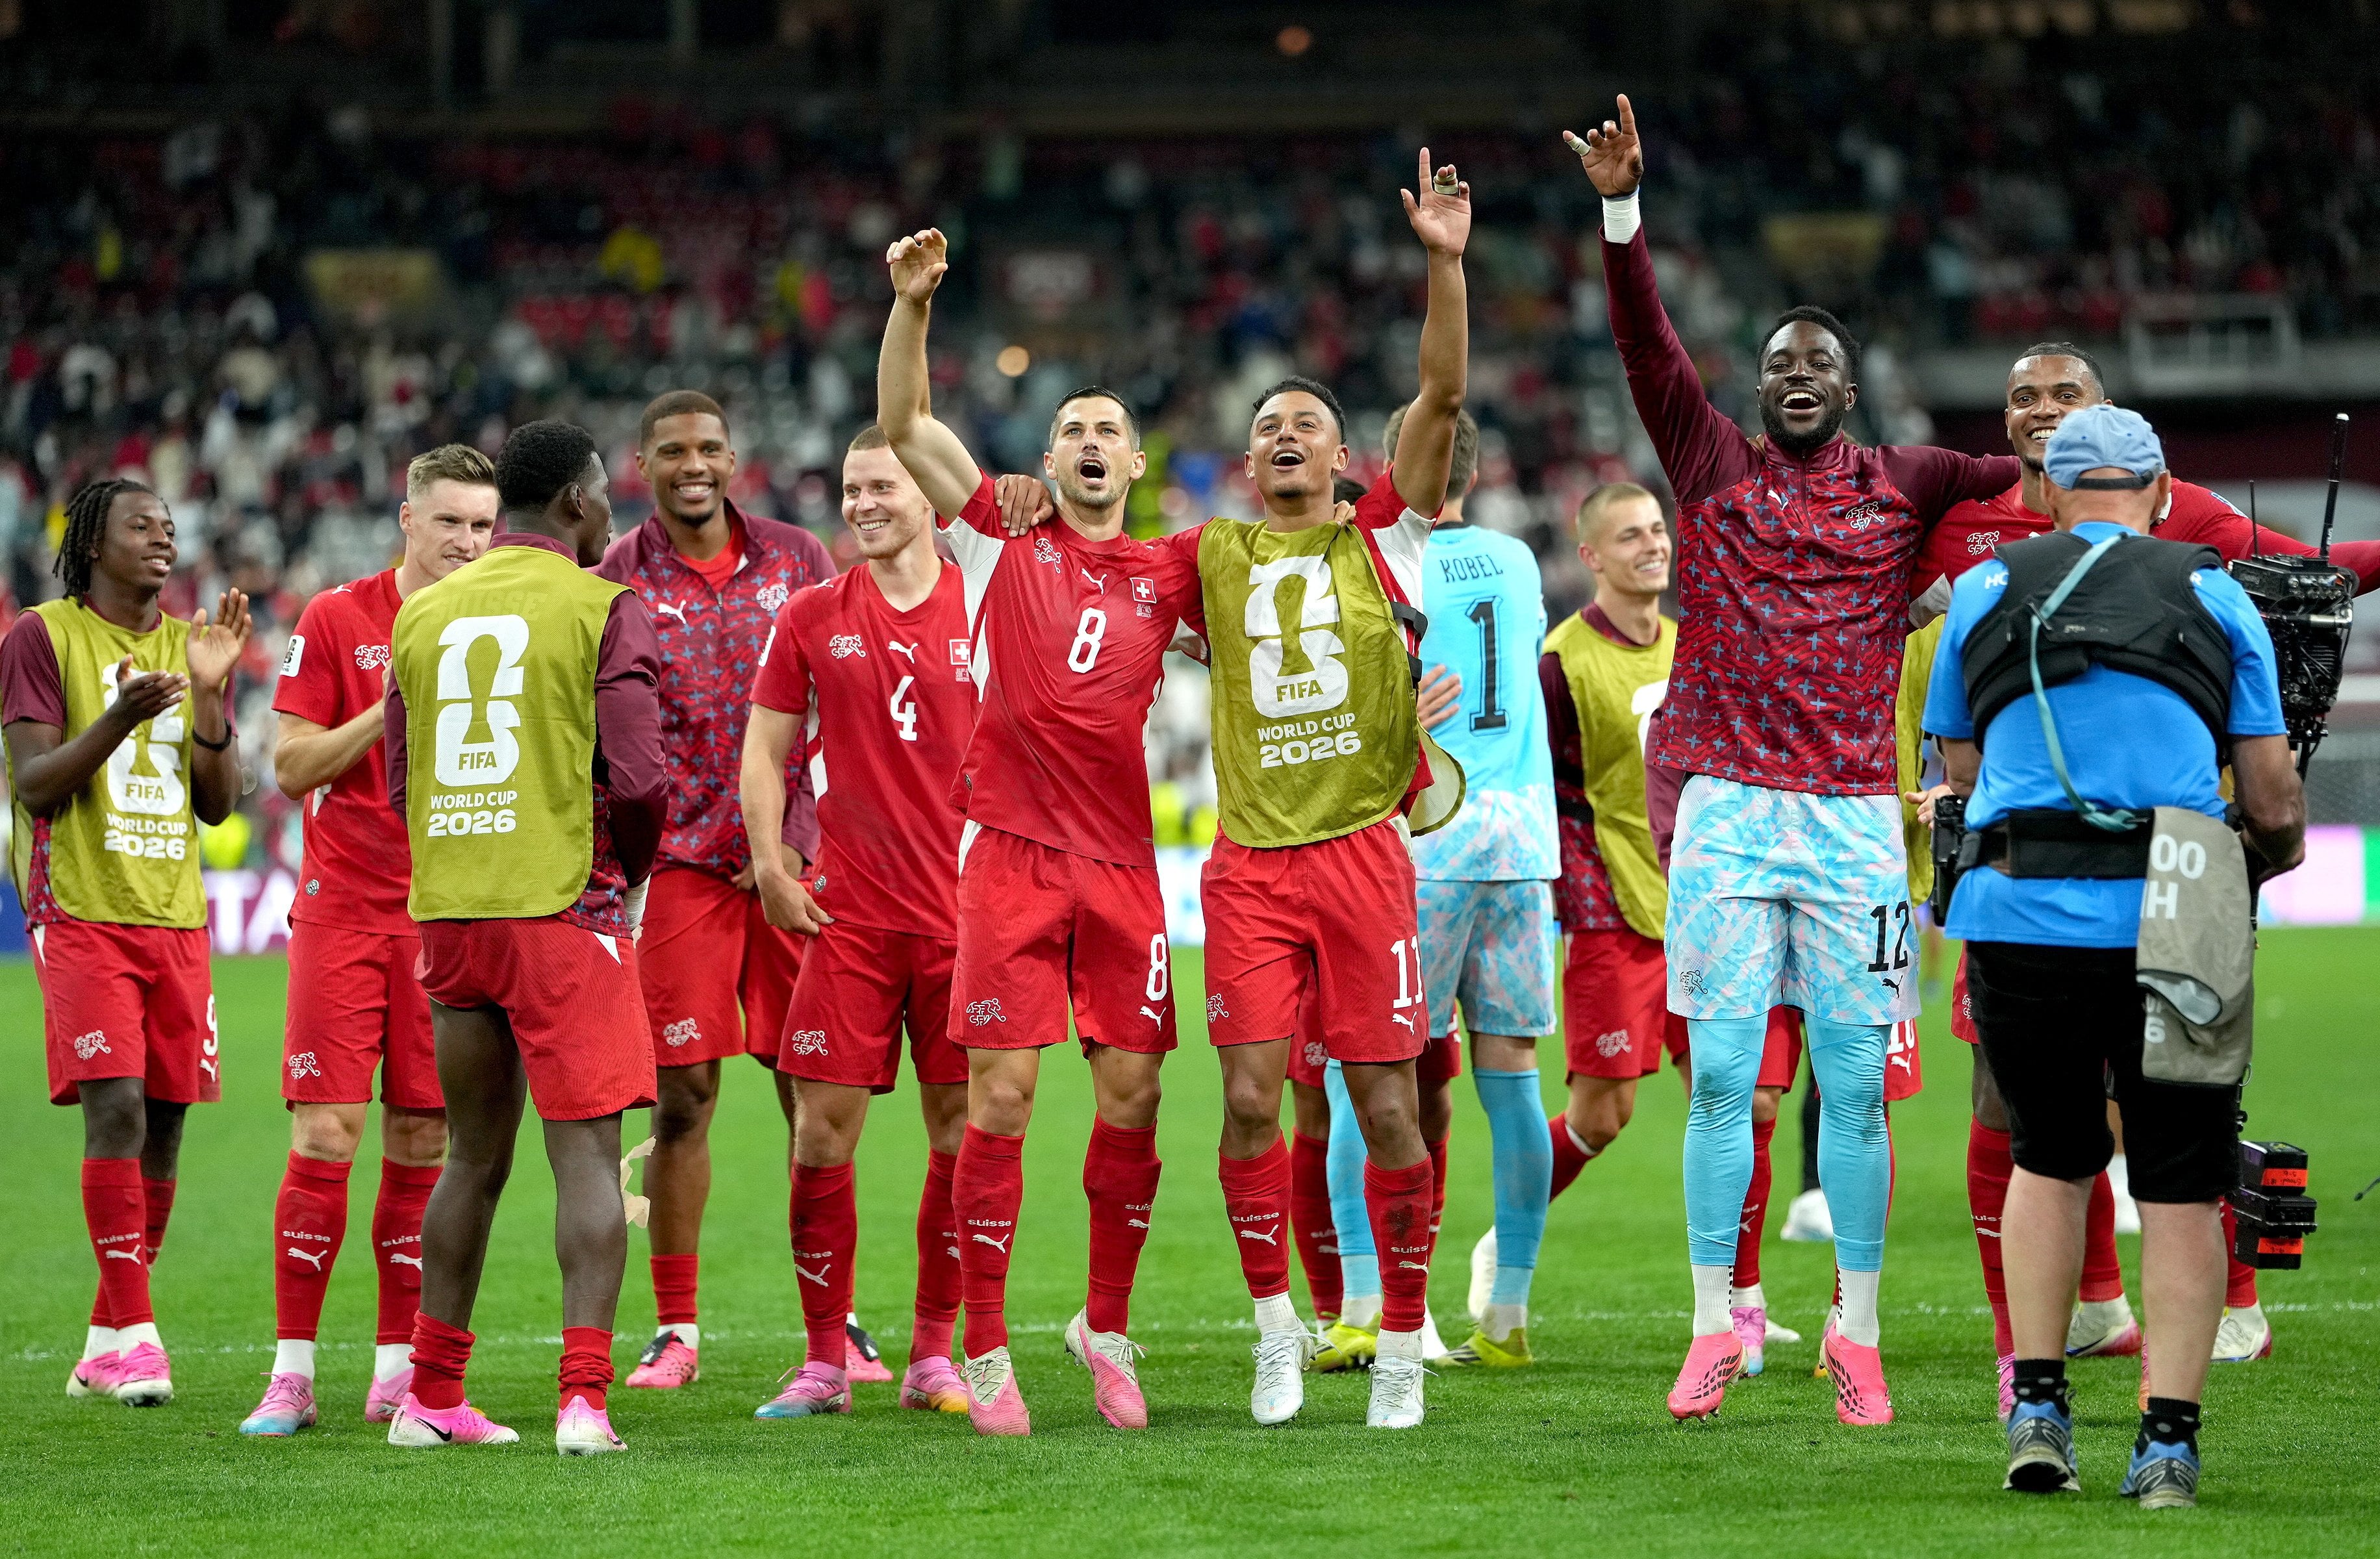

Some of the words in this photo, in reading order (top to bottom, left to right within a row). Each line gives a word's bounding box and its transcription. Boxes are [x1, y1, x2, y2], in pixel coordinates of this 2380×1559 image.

[1439, 555, 1504, 583] KOBEL
[1067, 607, 1108, 674] 8
[1465, 594, 1512, 737] 1
[1276, 679, 1323, 702] FIFA
[890, 674, 917, 741] 4
[1257, 720, 1320, 742] WORLD
[1321, 713, 1356, 732] CUP
[458, 752, 497, 770] FIFA
[1260, 731, 1361, 768] 2026
[125, 783, 164, 801] FIFA
[431, 792, 485, 810] WORLD
[487, 791, 518, 806] CUP
[106, 812, 156, 834] WORLD
[157, 820, 187, 835] CUP
[427, 810, 516, 837] 2026
[104, 829, 186, 861] 2026
[1867, 900, 1909, 972] 12
[1145, 932, 1167, 1002] 8
[1390, 935, 1423, 1008] 11
[203, 993, 218, 1056] 9
[967, 1219, 1011, 1227] suisse
[1232, 1212, 1280, 1222] suisse
[97, 1232, 140, 1245] suisse
[283, 1230, 331, 1243] suisse
[1391, 1242, 1428, 1253] suiss
